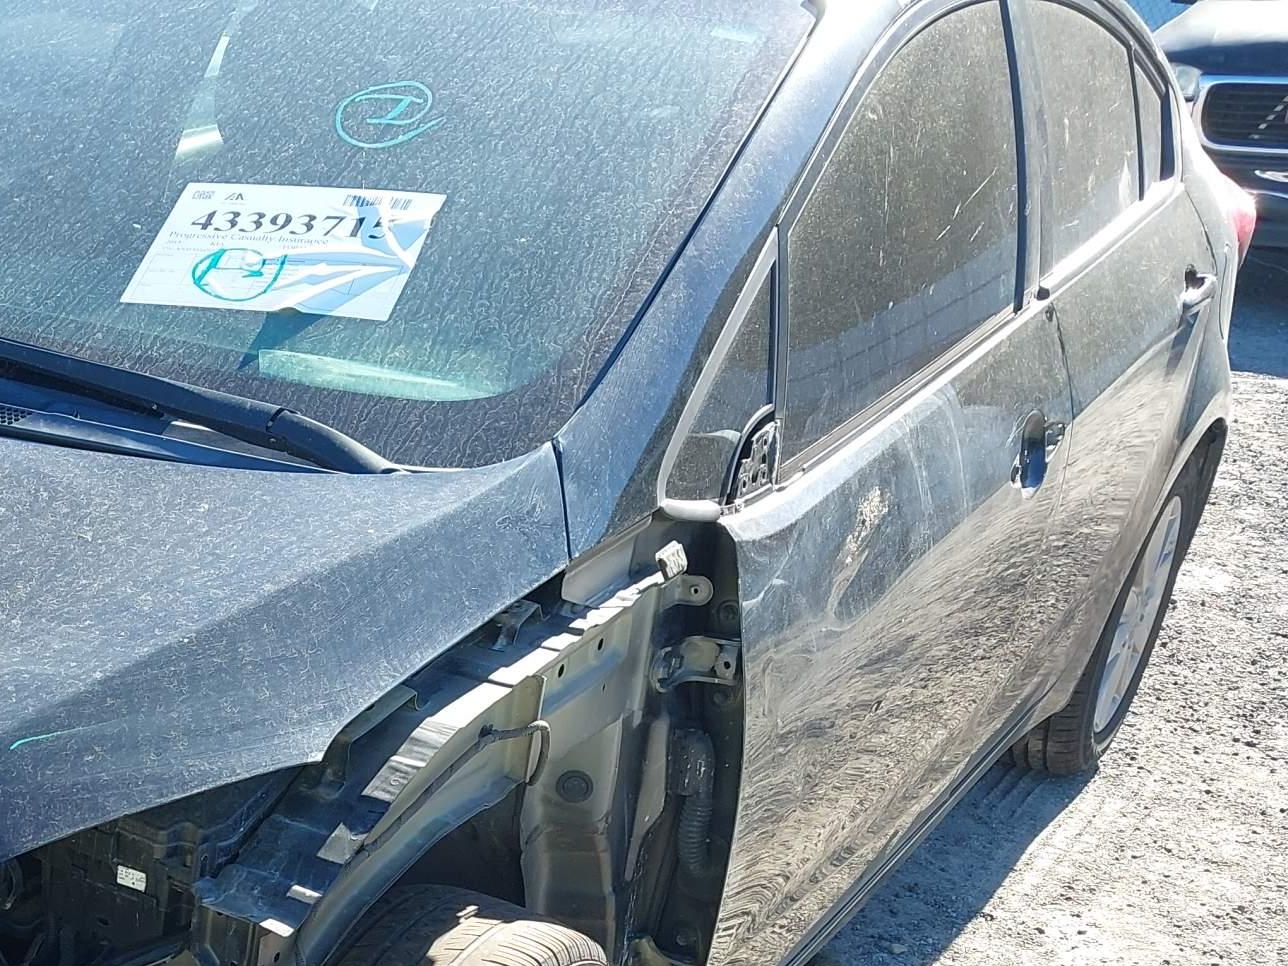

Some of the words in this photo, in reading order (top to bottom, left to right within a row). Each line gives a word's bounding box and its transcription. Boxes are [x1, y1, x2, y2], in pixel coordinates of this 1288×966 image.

[190, 209, 399, 240] 43393715
[169, 230, 228, 242] Progressive
[230, 233, 272, 244] Casualty
[278, 235, 330, 246] Insurance
